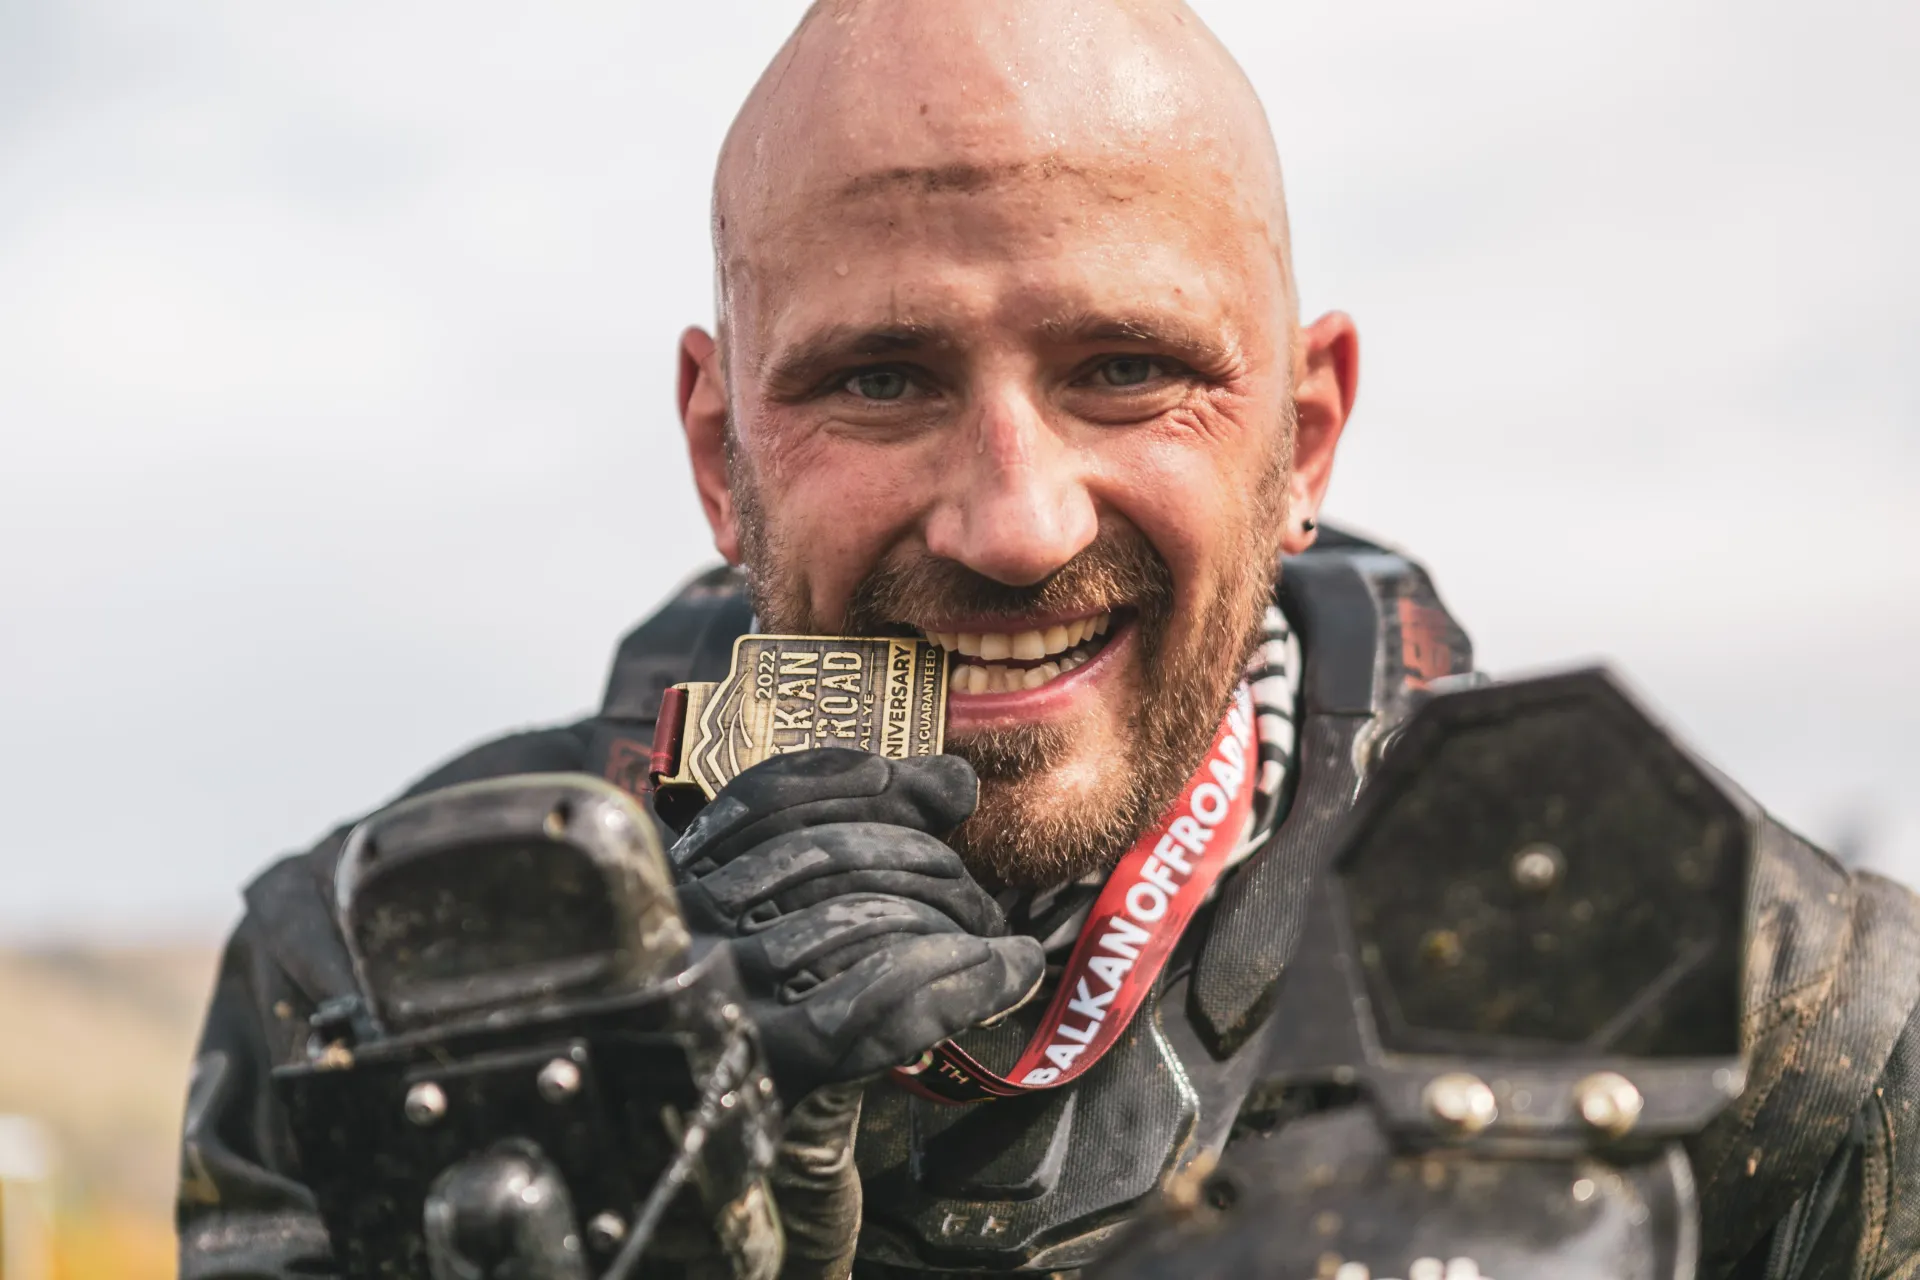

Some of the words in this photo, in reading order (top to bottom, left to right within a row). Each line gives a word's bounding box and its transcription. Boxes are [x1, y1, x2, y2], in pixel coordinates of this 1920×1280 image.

[755, 649, 777, 700] 2022
[770, 652, 818, 754] LKAN
[814, 650, 862, 748] ROAD
[886, 645, 911, 758] NIVERSARY
[920, 648, 936, 740] GUARANTEED
[860, 694, 875, 751] ALLYE
